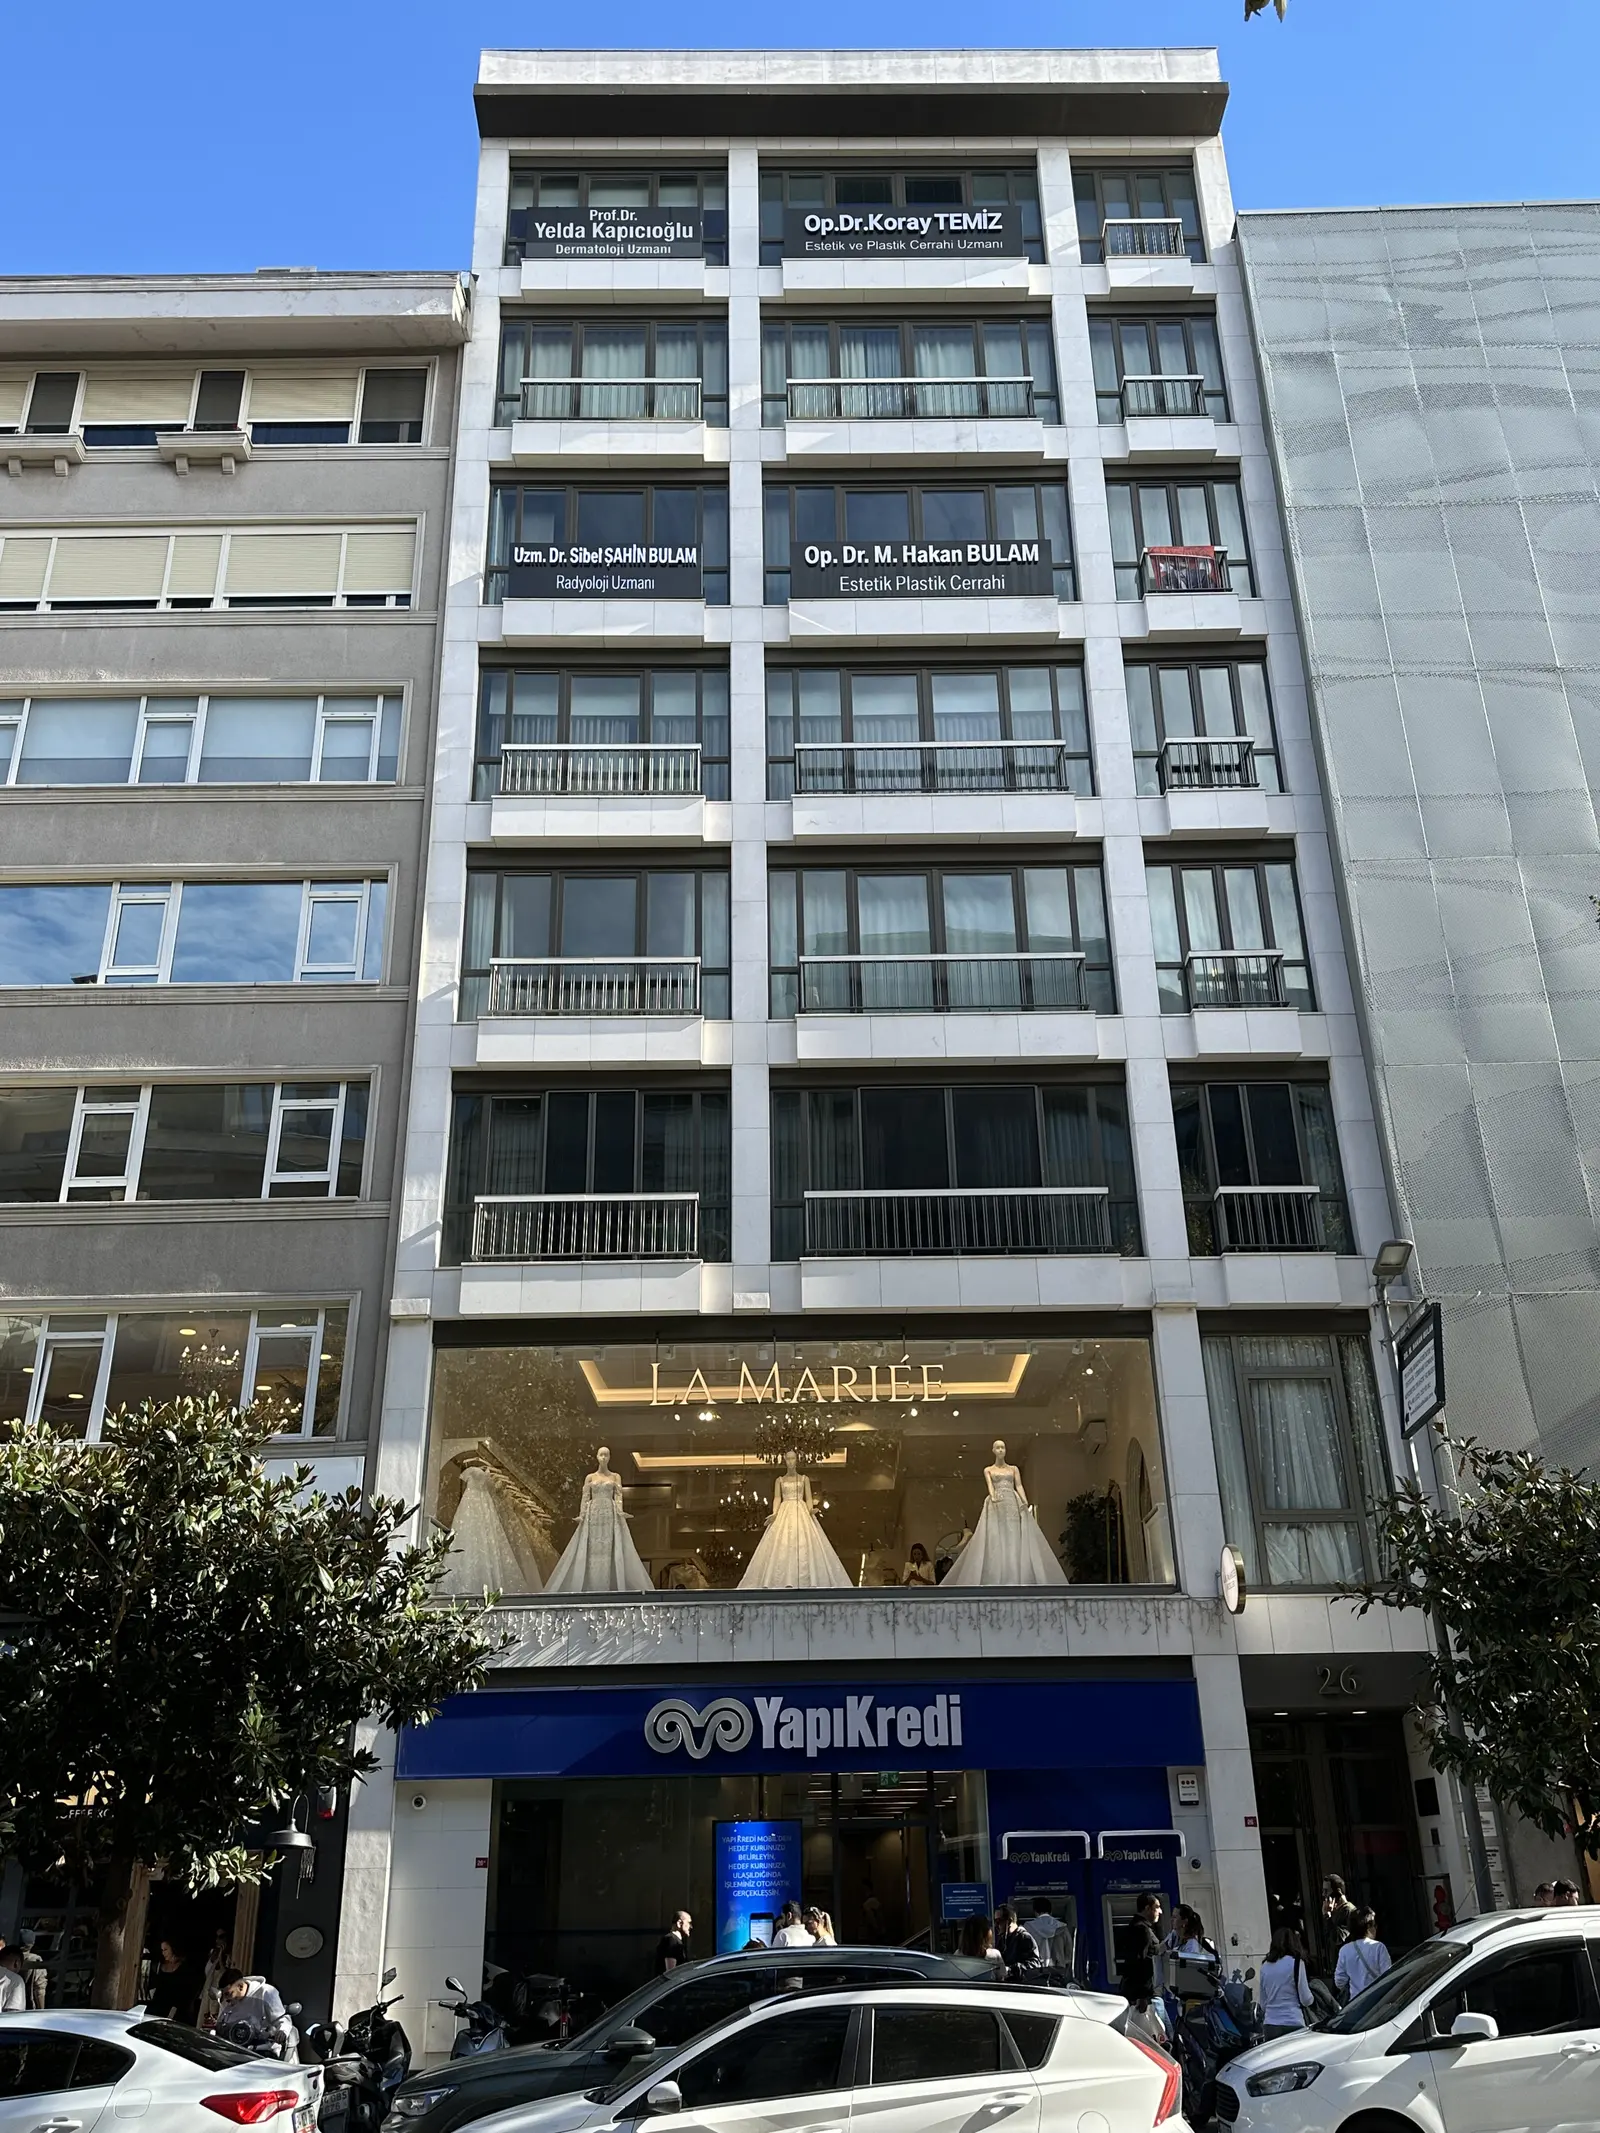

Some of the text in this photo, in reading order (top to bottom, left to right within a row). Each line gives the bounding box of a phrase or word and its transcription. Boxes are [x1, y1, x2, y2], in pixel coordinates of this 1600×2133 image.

[589, 209, 638, 221] Prof.Dr.
[804, 209, 1003, 235] Op.Dr.Koray TEMİZ
[534, 221, 693, 242] Yelda Kapıcıoğlu
[555, 244, 671, 256] Dermatoloji Uzmanı
[805, 239, 1003, 251] Estetik ve Plastik Cerrahi Uzmanı
[513, 544, 697, 567] Uzm. Dr. Sibel ŞAHİN BULAM
[804, 543, 1039, 568] Op. Dr. M. Hakan BULAM
[556, 574, 655, 593] Radyoloji Uzmanı
[839, 574, 1005, 592] Estetik Plastik Cerrahi
[649, 1353, 949, 1406] LA MARIÉE
[1316, 1664, 1362, 1695] 26
[753, 1694, 963, 1758] YapıKredi
[728, 1863, 749, 1871] HEDEF
